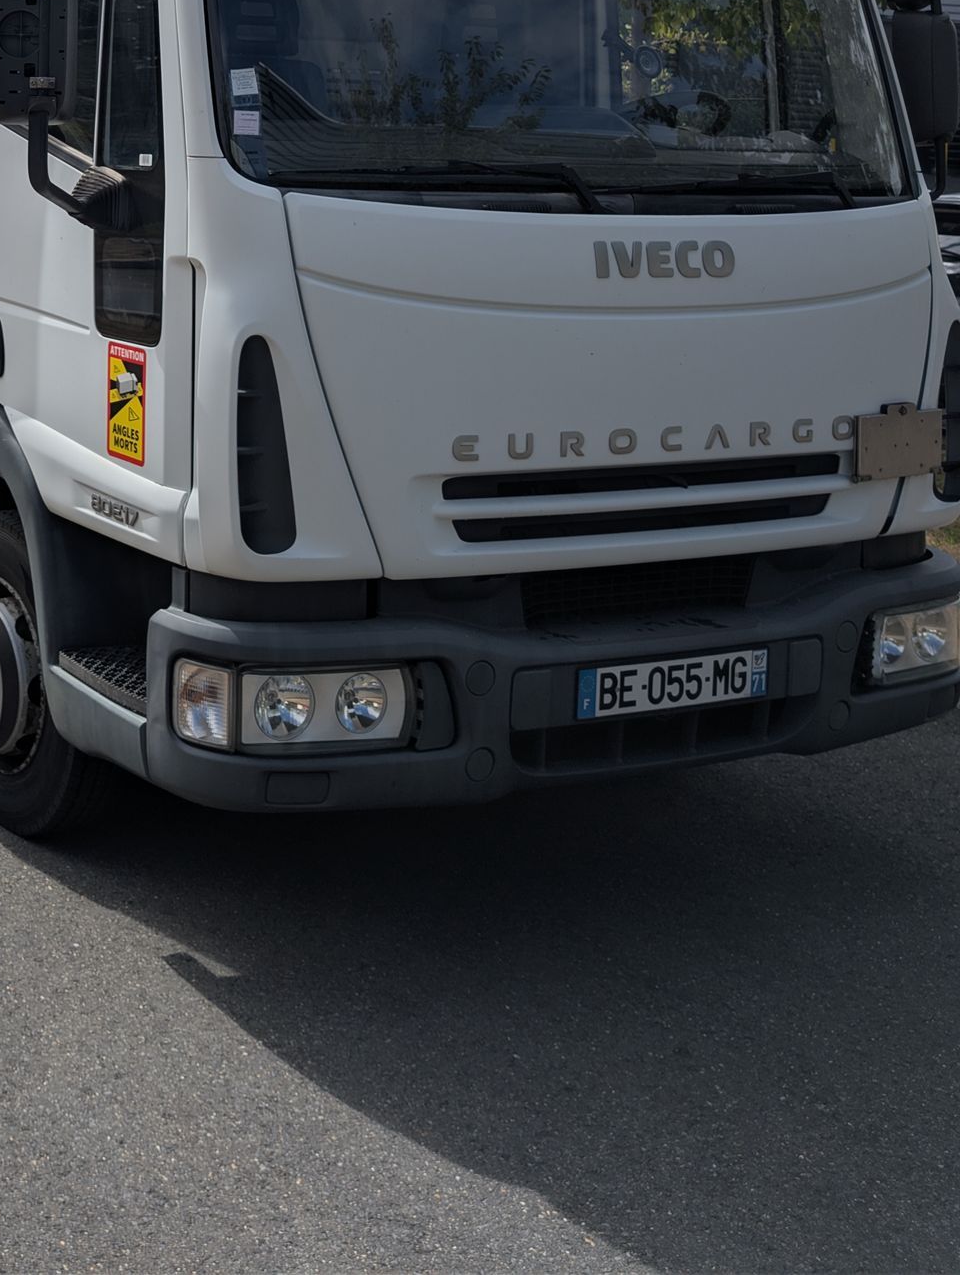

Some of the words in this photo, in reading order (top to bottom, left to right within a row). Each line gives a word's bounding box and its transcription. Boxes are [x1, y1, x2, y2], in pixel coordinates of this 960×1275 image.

[593, 240, 736, 279] IVECO
[110, 344, 145, 363] ATTENTION
[113, 423, 139, 441] ANGLES
[452, 415, 854, 462] EUROCARGO
[114, 436, 138, 453] MORTS
[599, 656, 747, 711] BE-055-MG
[752, 673, 767, 694] 71
[583, 698, 590, 711] F
